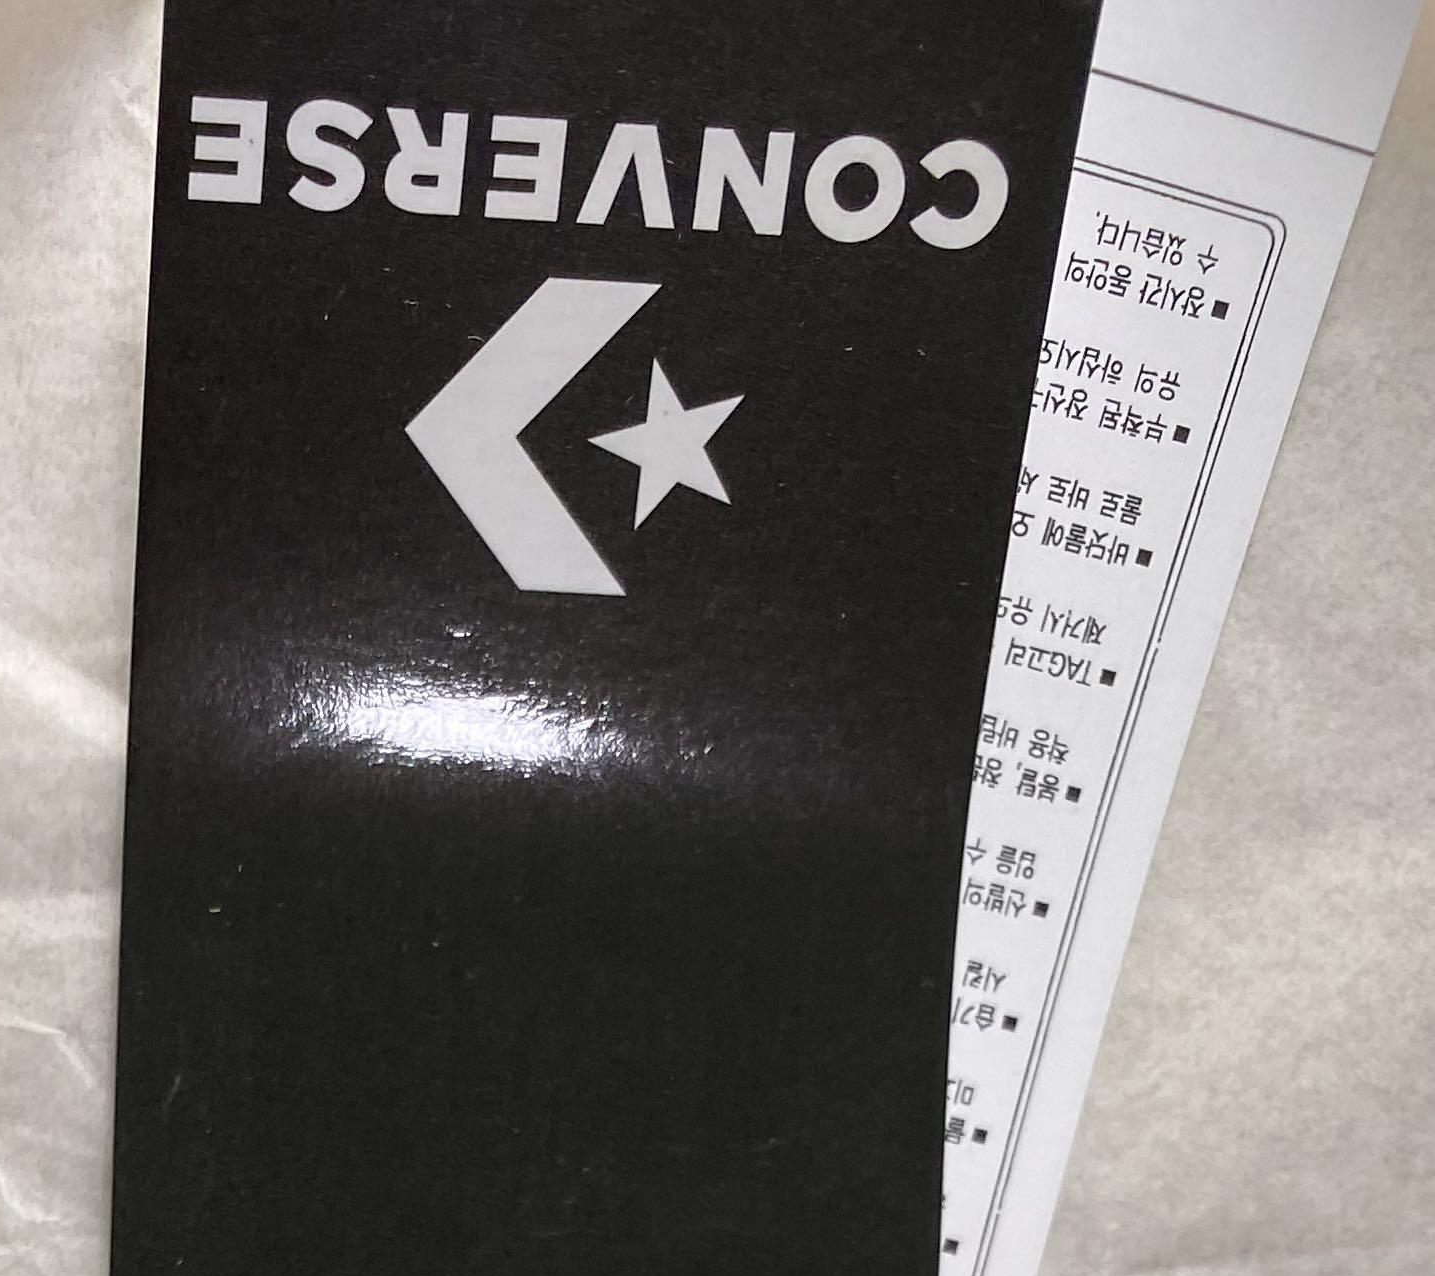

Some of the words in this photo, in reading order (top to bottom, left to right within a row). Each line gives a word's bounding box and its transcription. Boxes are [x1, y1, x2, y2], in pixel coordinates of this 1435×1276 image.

[188, 96, 1009, 250] CONVERSE
[1095, 212, 1187, 267] 있습니다.
[1197, 245, 1219, 275] 수
[1064, 252, 1132, 298] 동안의
[1139, 273, 1206, 319] 장시간
[1134, 364, 1180, 401] 유의
[1098, 398, 1167, 444] 부착된
[1047, 475, 1090, 511] 바로
[1100, 490, 1143, 526] 물로
[1041, 516, 1130, 566] 바닷물에
[1040, 604, 1107, 645] 제거시
[1004, 637, 1093, 686] TAG고리
[1028, 728, 1069, 764] 착용
[962, 877, 1027, 919] 신발의
